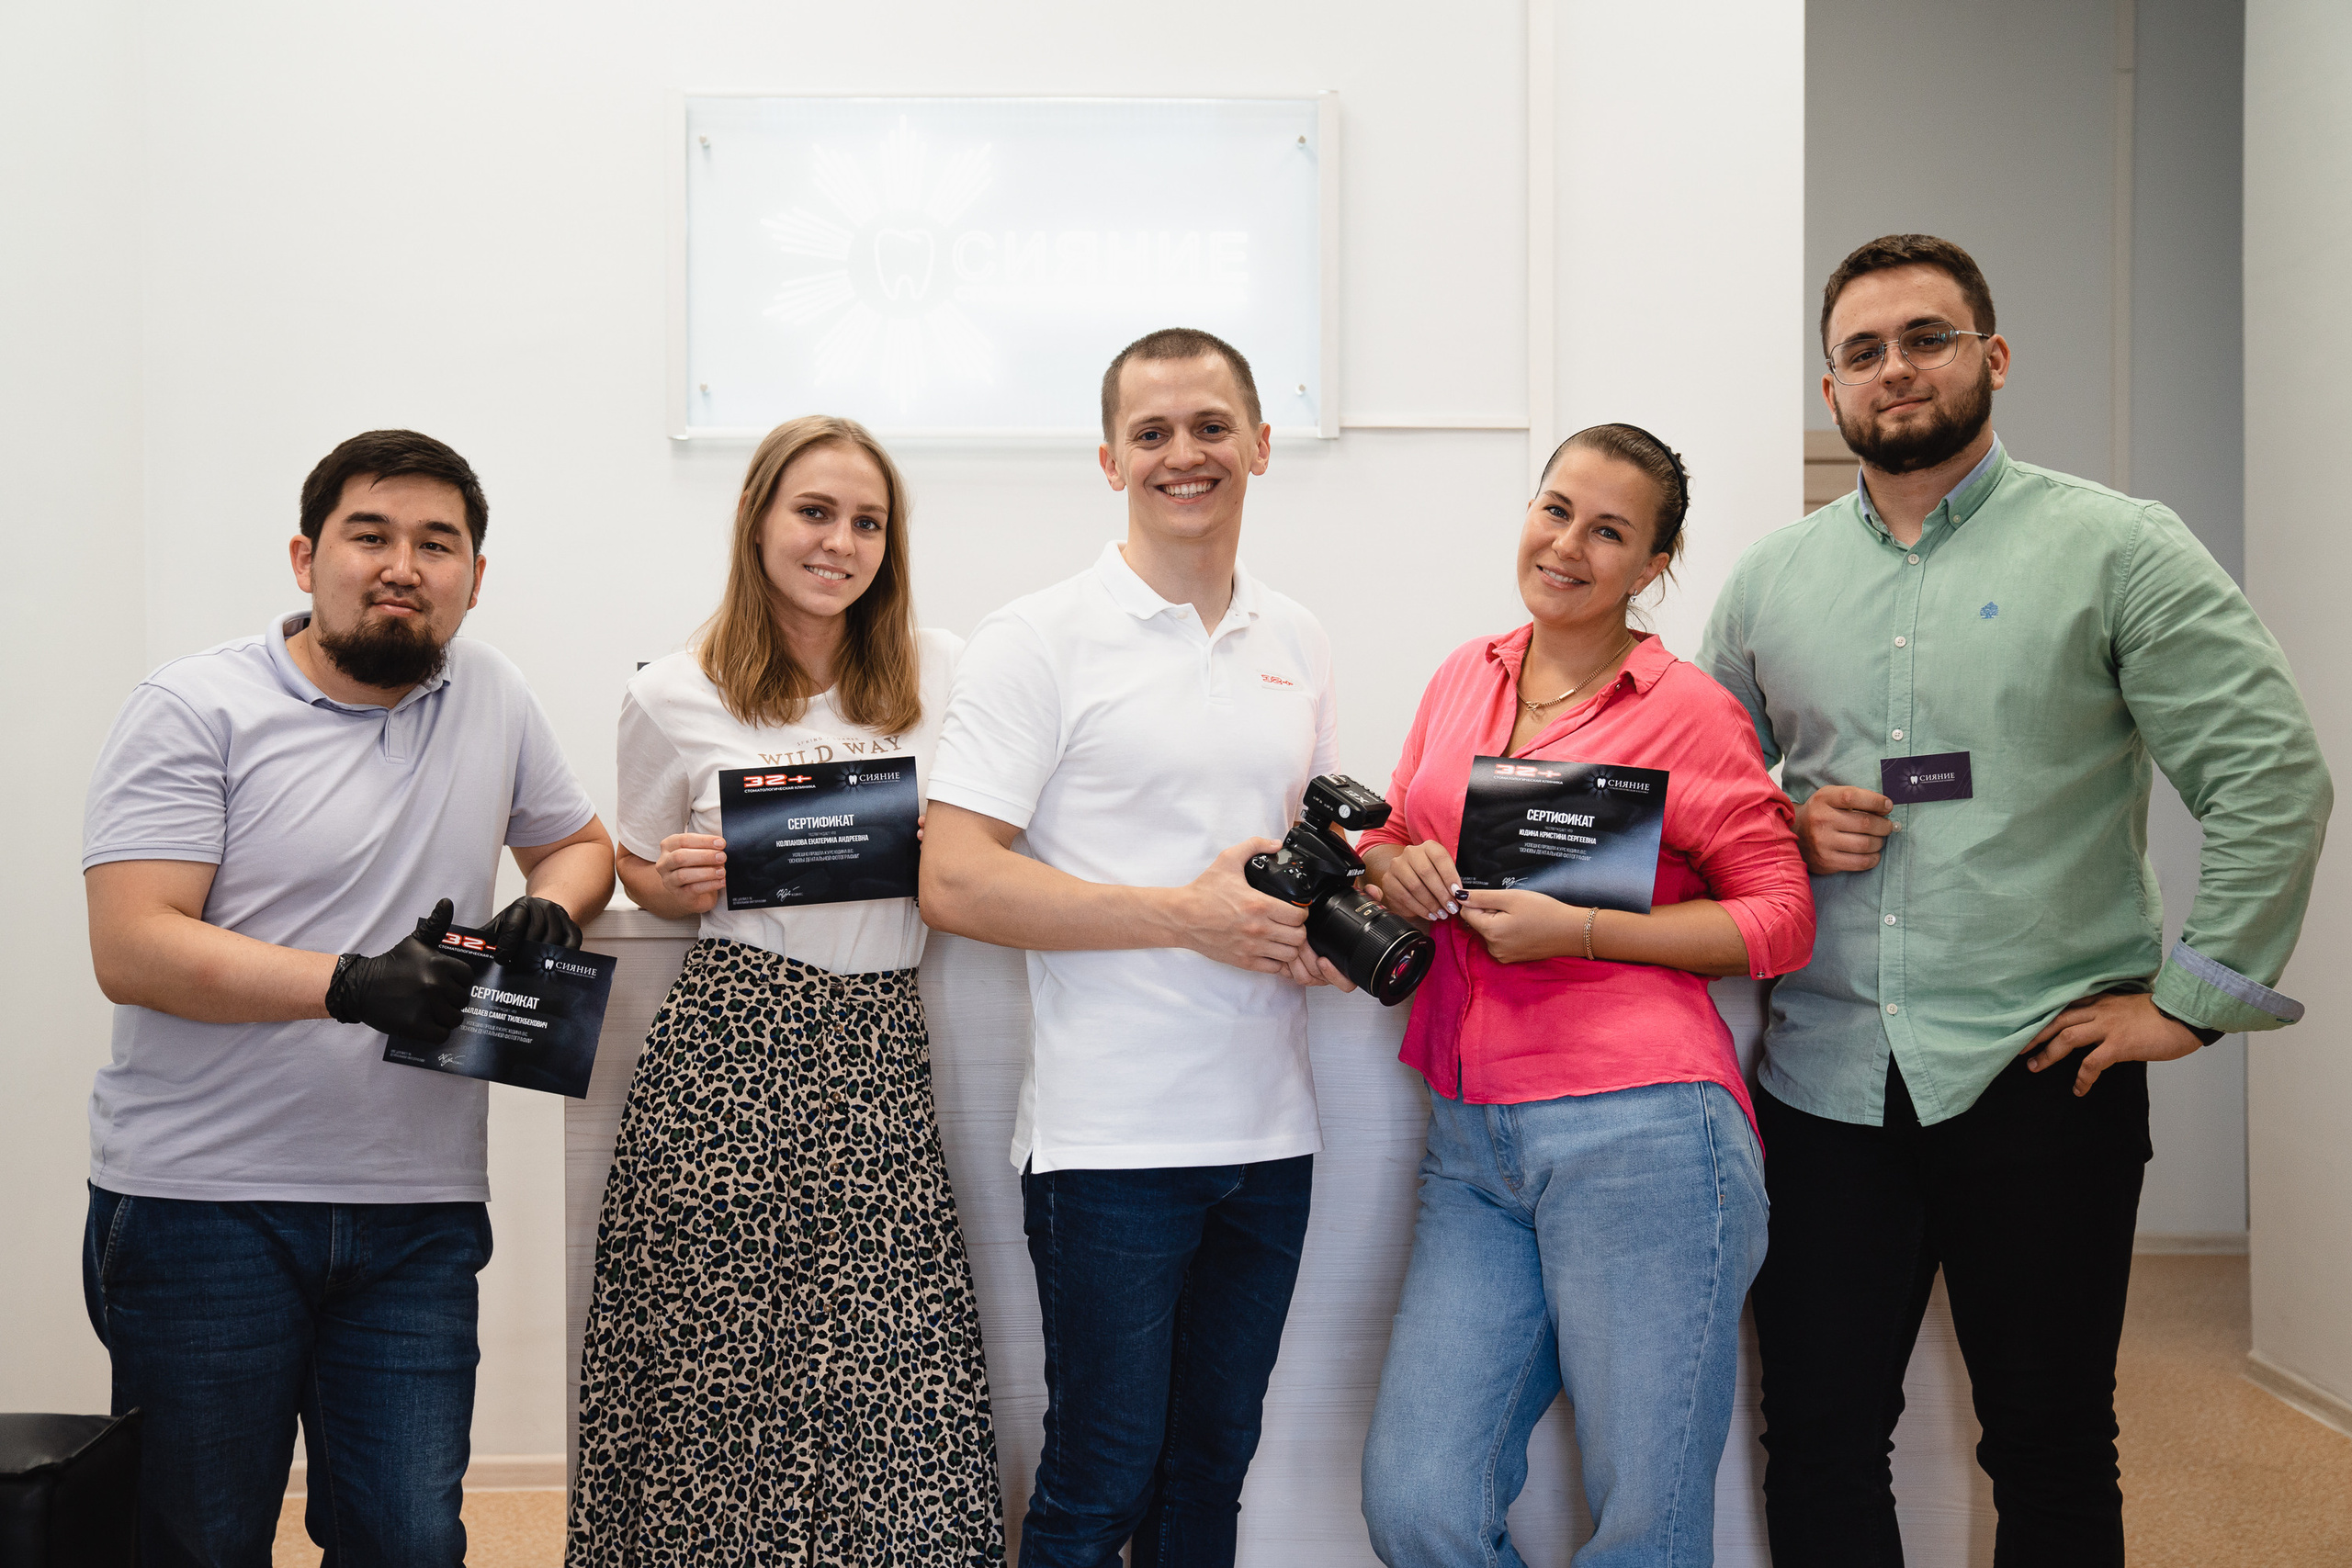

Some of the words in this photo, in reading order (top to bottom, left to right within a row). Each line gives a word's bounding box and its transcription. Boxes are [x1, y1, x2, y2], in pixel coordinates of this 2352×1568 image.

[952, 230, 1249, 283] СИЯНИЕ
[758, 745, 833, 766] WILD
[842, 735, 901, 754] WAY
[859, 772, 900, 782] СИЯНИЕ
[1494, 763, 1562, 778] 32+
[1919, 773, 1955, 782] СИЯНИЕ
[743, 773, 812, 788] 32+
[1608, 779, 1650, 791] СИЯНИЕ
[744, 785, 794, 794] СТОМАТОЛОГИЧЕСКАЯ
[787, 814, 854, 830] СЕРТИФИКАТ
[1526, 808, 1595, 828] СЕРТИФИКАТ
[775, 838, 808, 847] КОЛПАКОВА
[808, 836, 838, 845] ЕКАТЕРИНА
[838, 834, 869, 843] АНДРЕЕВНА
[1519, 829, 1539, 838] ЮДИНА
[1539, 830, 1566, 840] КРИСТИНА
[1566, 834, 1597, 845] СЕРГЕЕВНА
[438, 944, 489, 958] СТОМАТОЛОГИЧЕСКАЯ
[555, 961, 597, 976] СИЯНИЕ
[470, 985, 540, 1010] СЕРТИФИКАТ
[489, 1011, 507, 1021] САМАТ
[507, 1014, 548, 1029] ТИЛЕКБЕКОВИЧ
